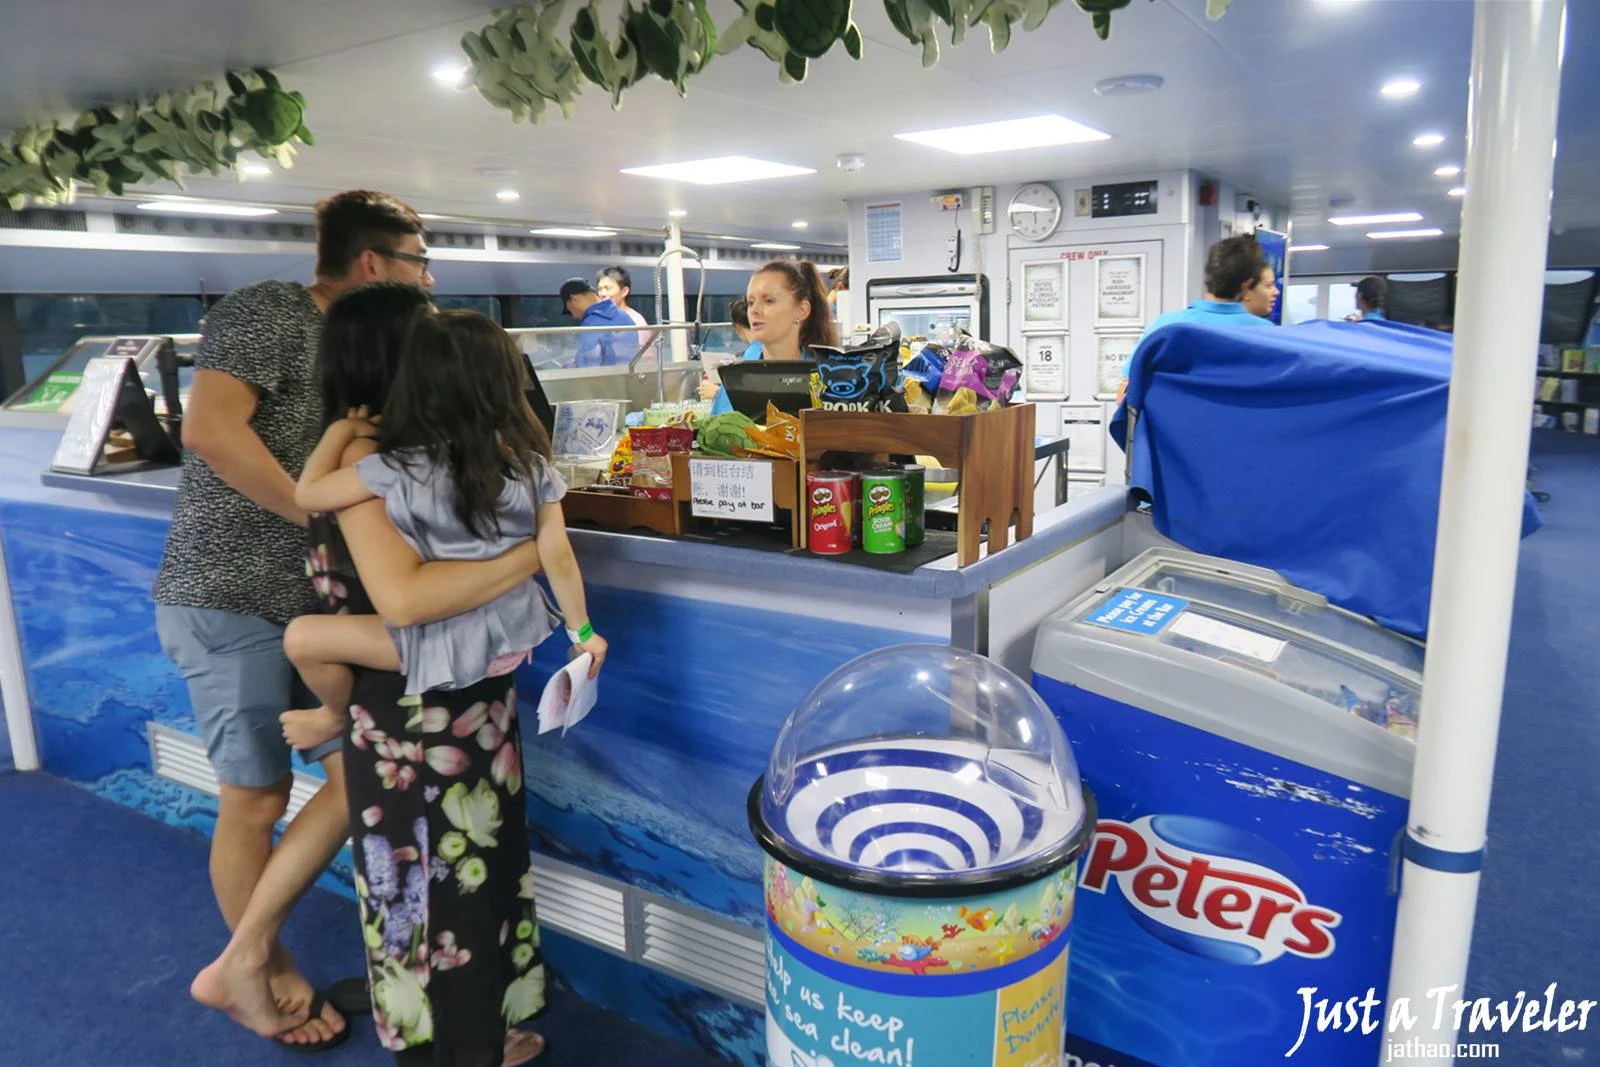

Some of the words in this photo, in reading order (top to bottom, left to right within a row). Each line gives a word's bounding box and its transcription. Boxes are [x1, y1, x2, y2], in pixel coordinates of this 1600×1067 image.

[1060, 251, 1085, 261] CREW
[1039, 350, 1053, 362] 18
[718, 500, 736, 513] pay
[738, 501, 747, 509] at
[750, 501, 766, 511] bar
[1082, 821, 1336, 955] Peters
[800, 985, 824, 1011] us
[837, 991, 904, 1043] keep
[784, 1003, 819, 1041] sea
[830, 1027, 914, 1067] clean!
